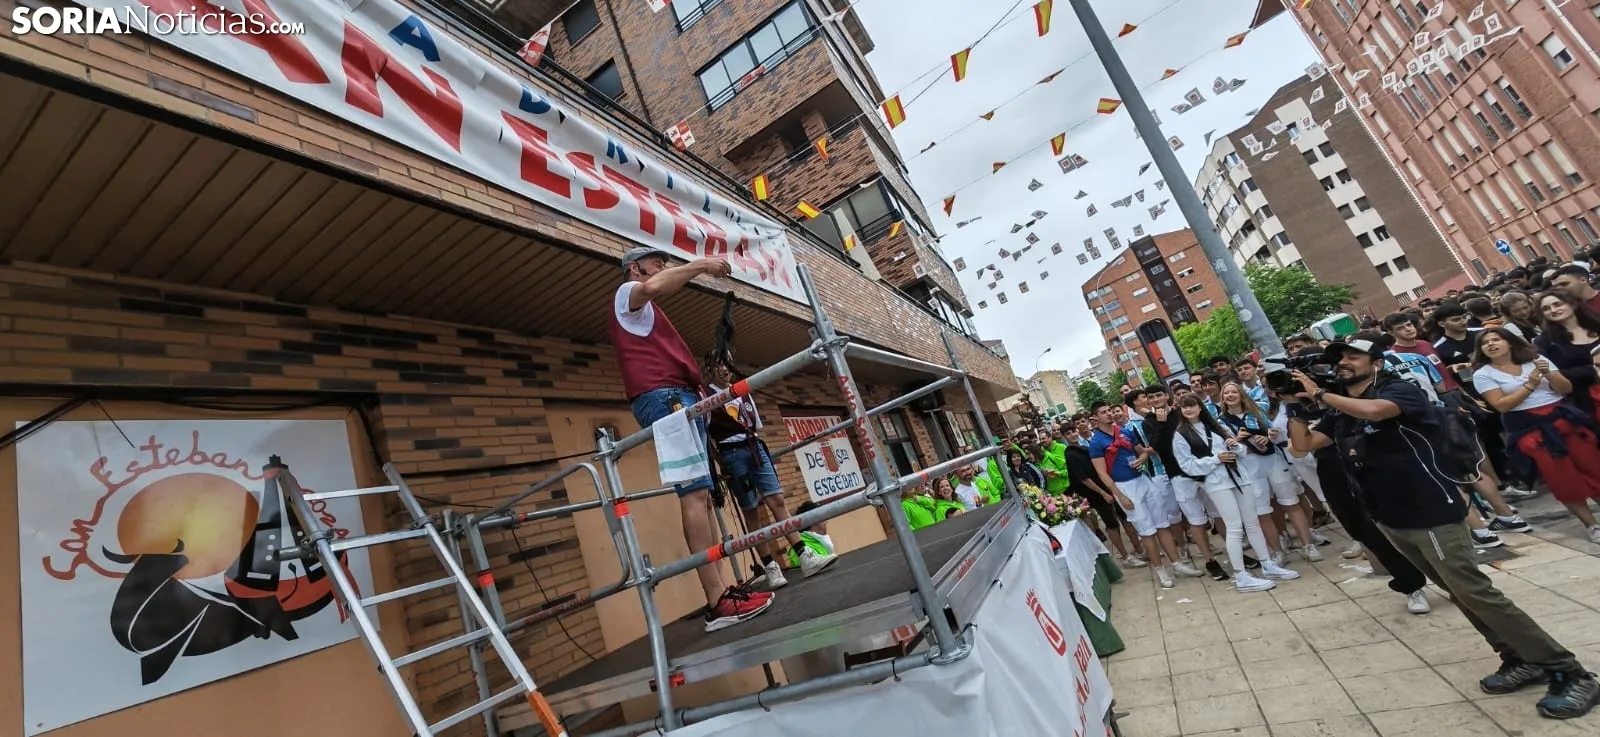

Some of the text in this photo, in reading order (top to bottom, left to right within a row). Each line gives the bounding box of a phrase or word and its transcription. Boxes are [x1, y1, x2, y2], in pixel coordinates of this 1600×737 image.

[90, 430, 264, 490] Esteban
[804, 451, 825, 470] DE
[813, 471, 861, 497] ESTEBAN
